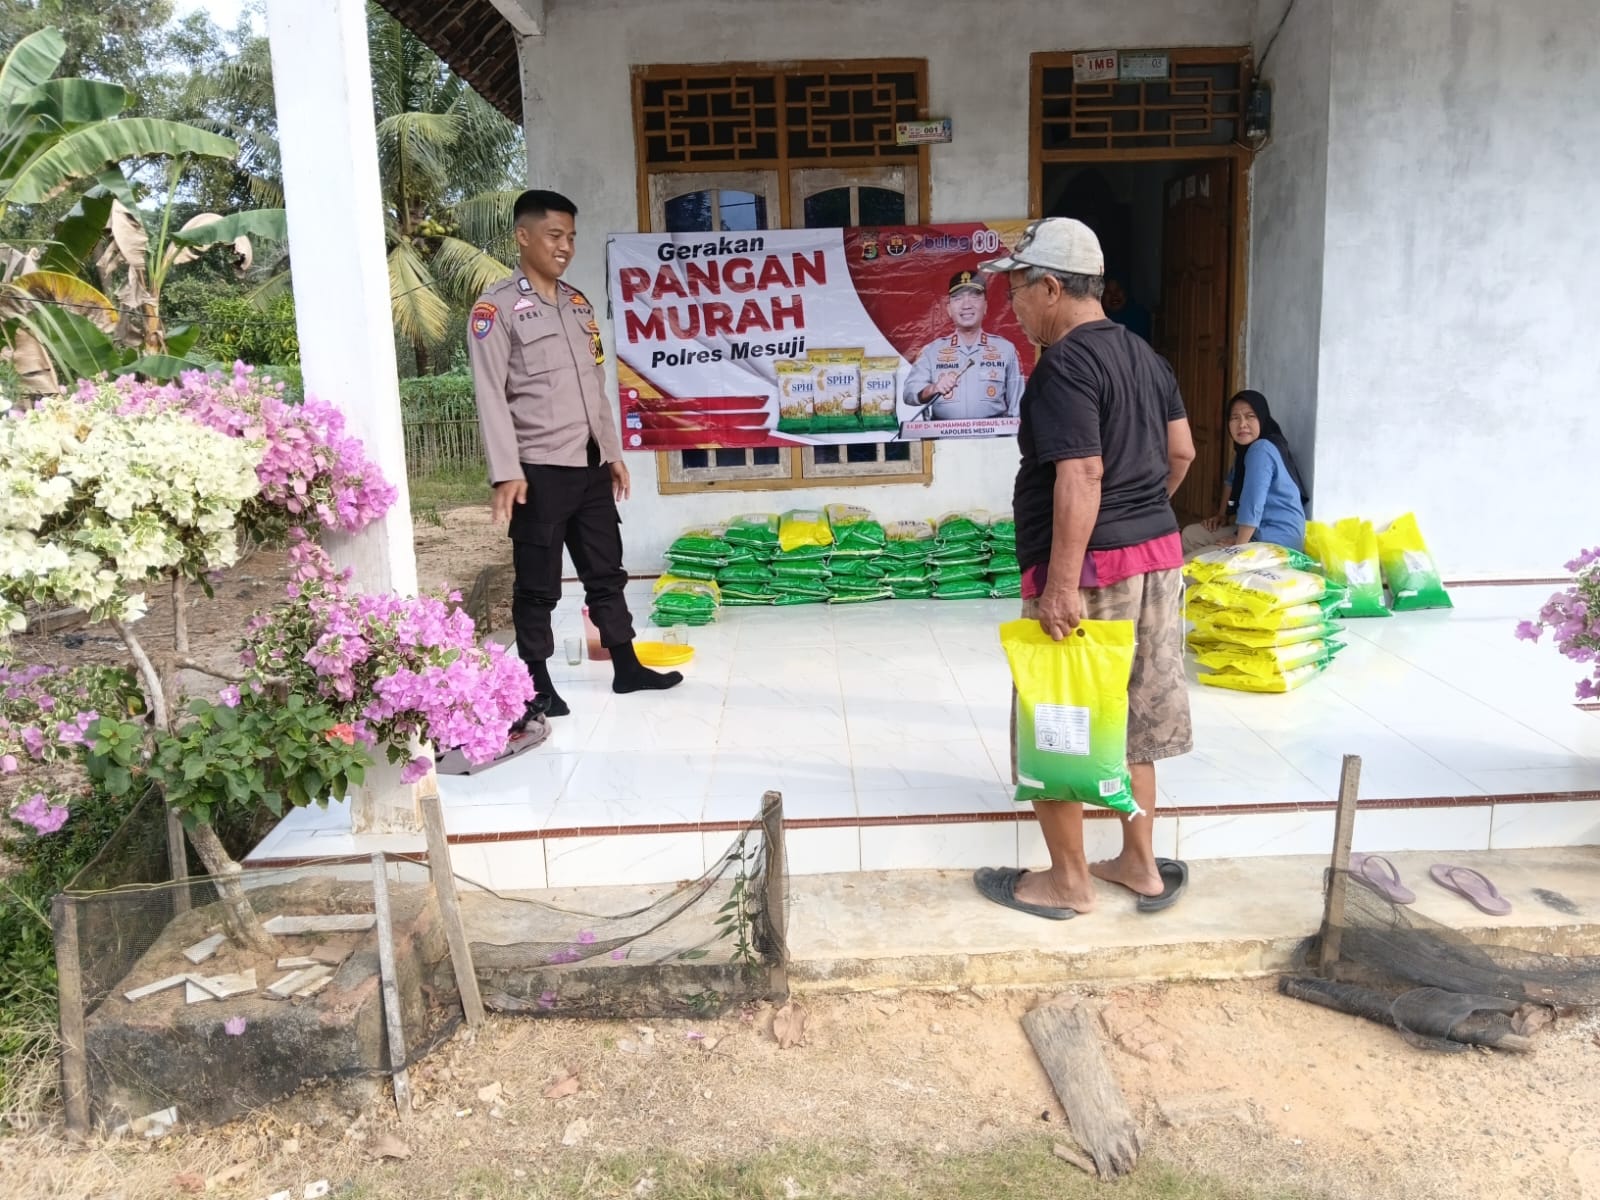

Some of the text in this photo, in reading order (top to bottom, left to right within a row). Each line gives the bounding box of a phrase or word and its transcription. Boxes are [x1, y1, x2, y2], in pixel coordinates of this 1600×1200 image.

[1089, 58, 1114, 70] IMB
[923, 126, 938, 134] 001
[657, 236, 764, 262] Gerakan
[619, 250, 827, 303] PANGAN
[624, 294, 805, 344] MURAH
[652, 348, 723, 368] Polres
[730, 336, 805, 360] Mesuji
[826, 375, 854, 385] SPHP
[866, 380, 891, 390] SPHP
